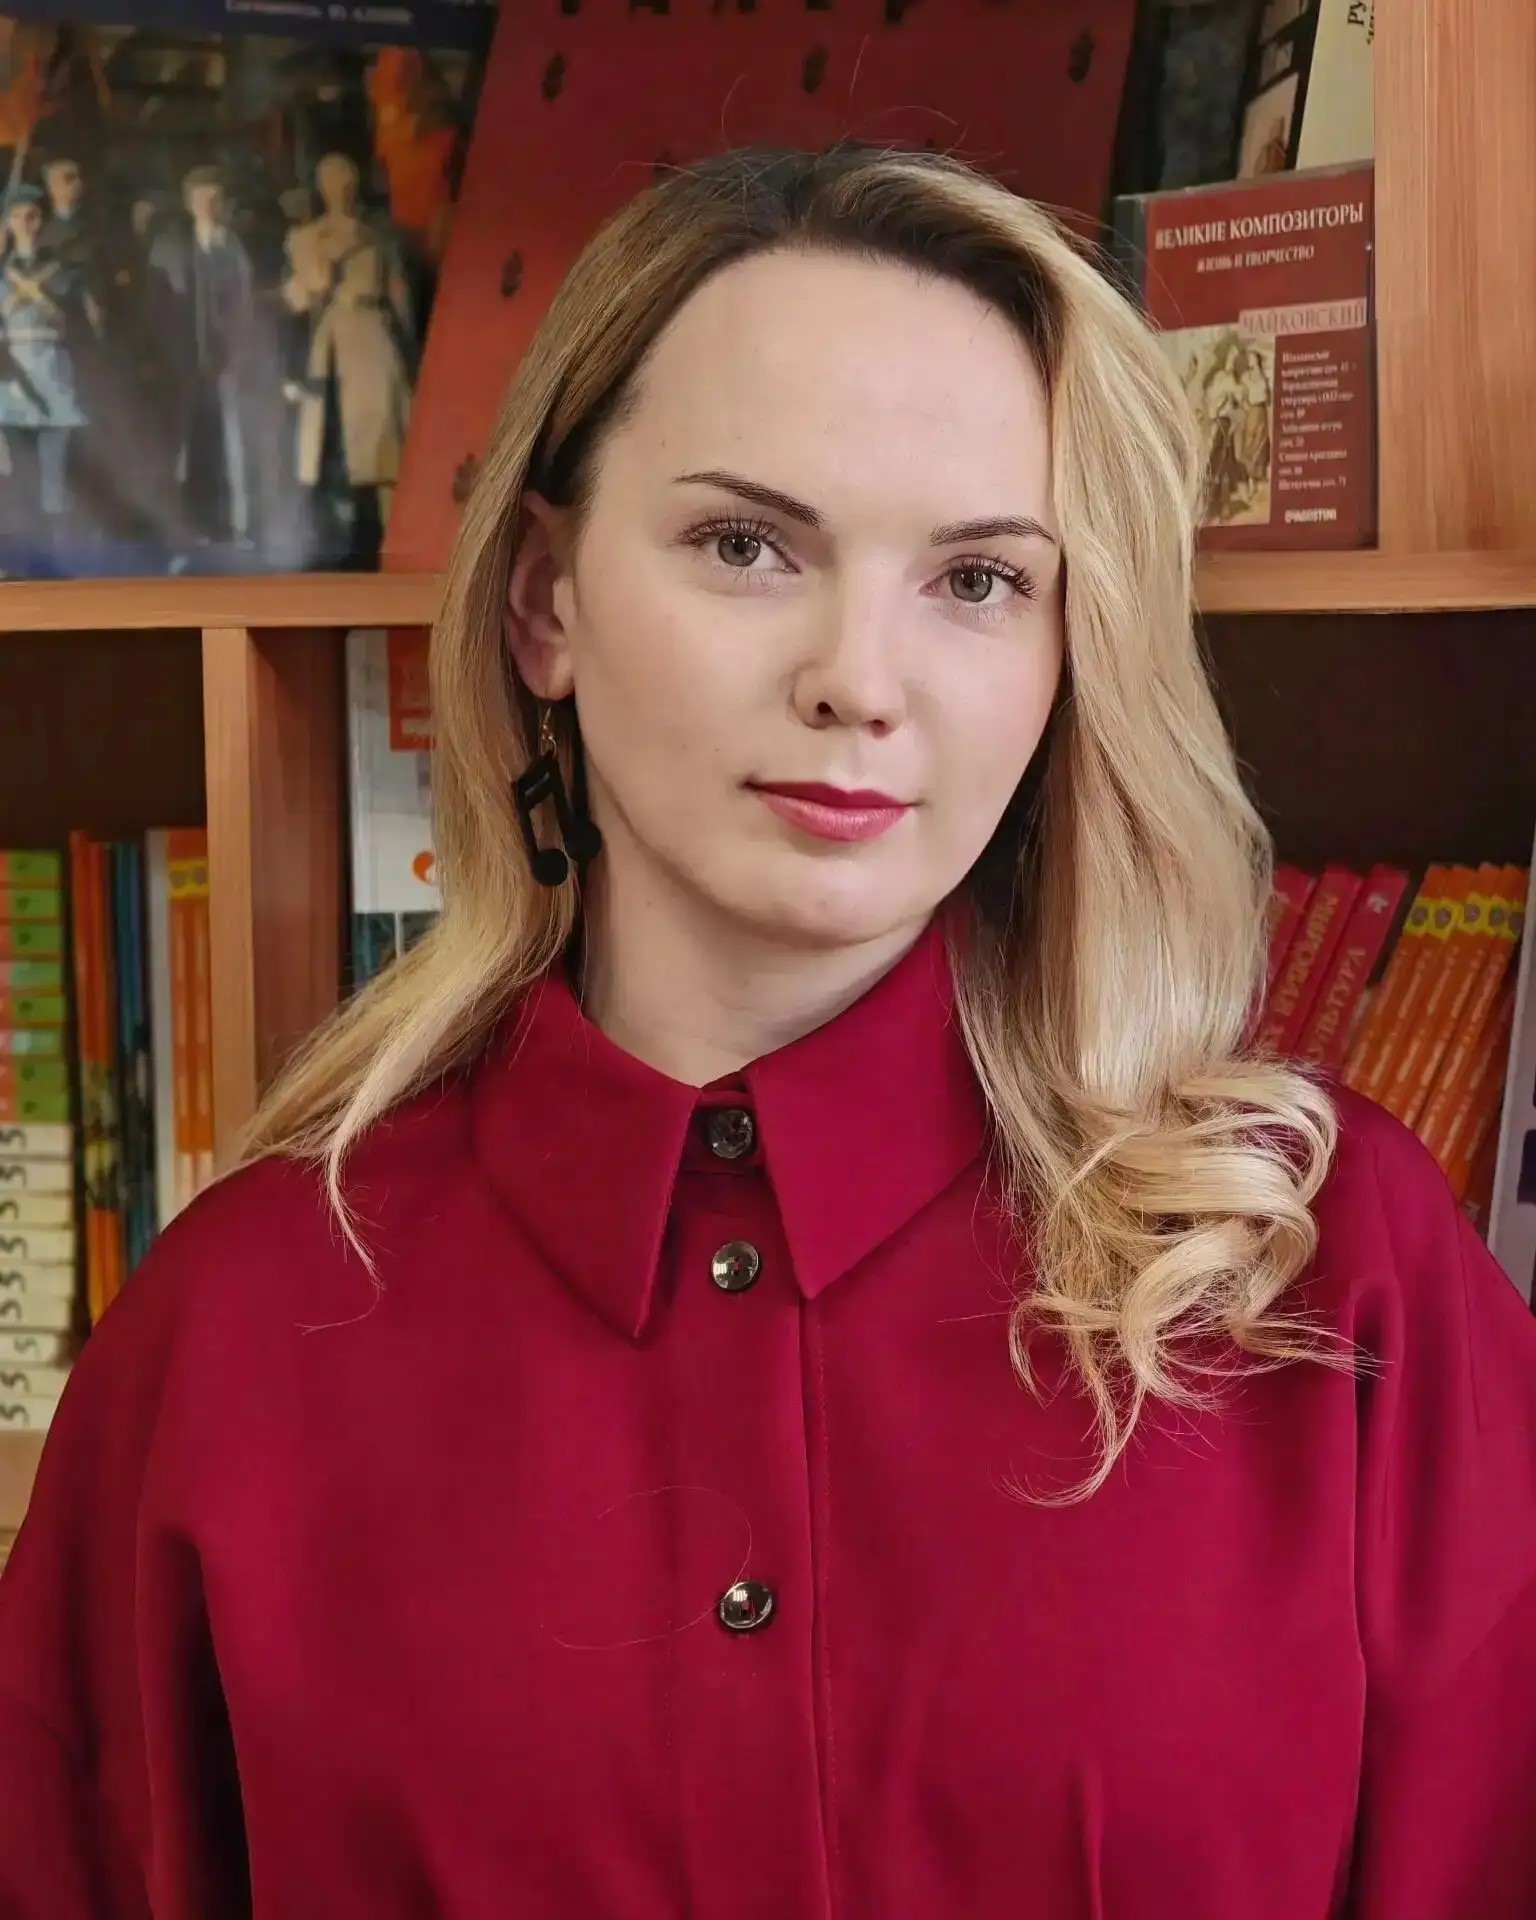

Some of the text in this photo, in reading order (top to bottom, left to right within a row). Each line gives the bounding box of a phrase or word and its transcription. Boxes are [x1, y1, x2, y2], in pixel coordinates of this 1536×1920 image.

[1155, 202, 1363, 250] ВЕЛИКИЕ КОМПОЗИТОРЫ
[1245, 245, 1315, 267] ТВОРЧЕСТВО
[1243, 303, 1365, 333] ЧАЙКОВСКИЙ
